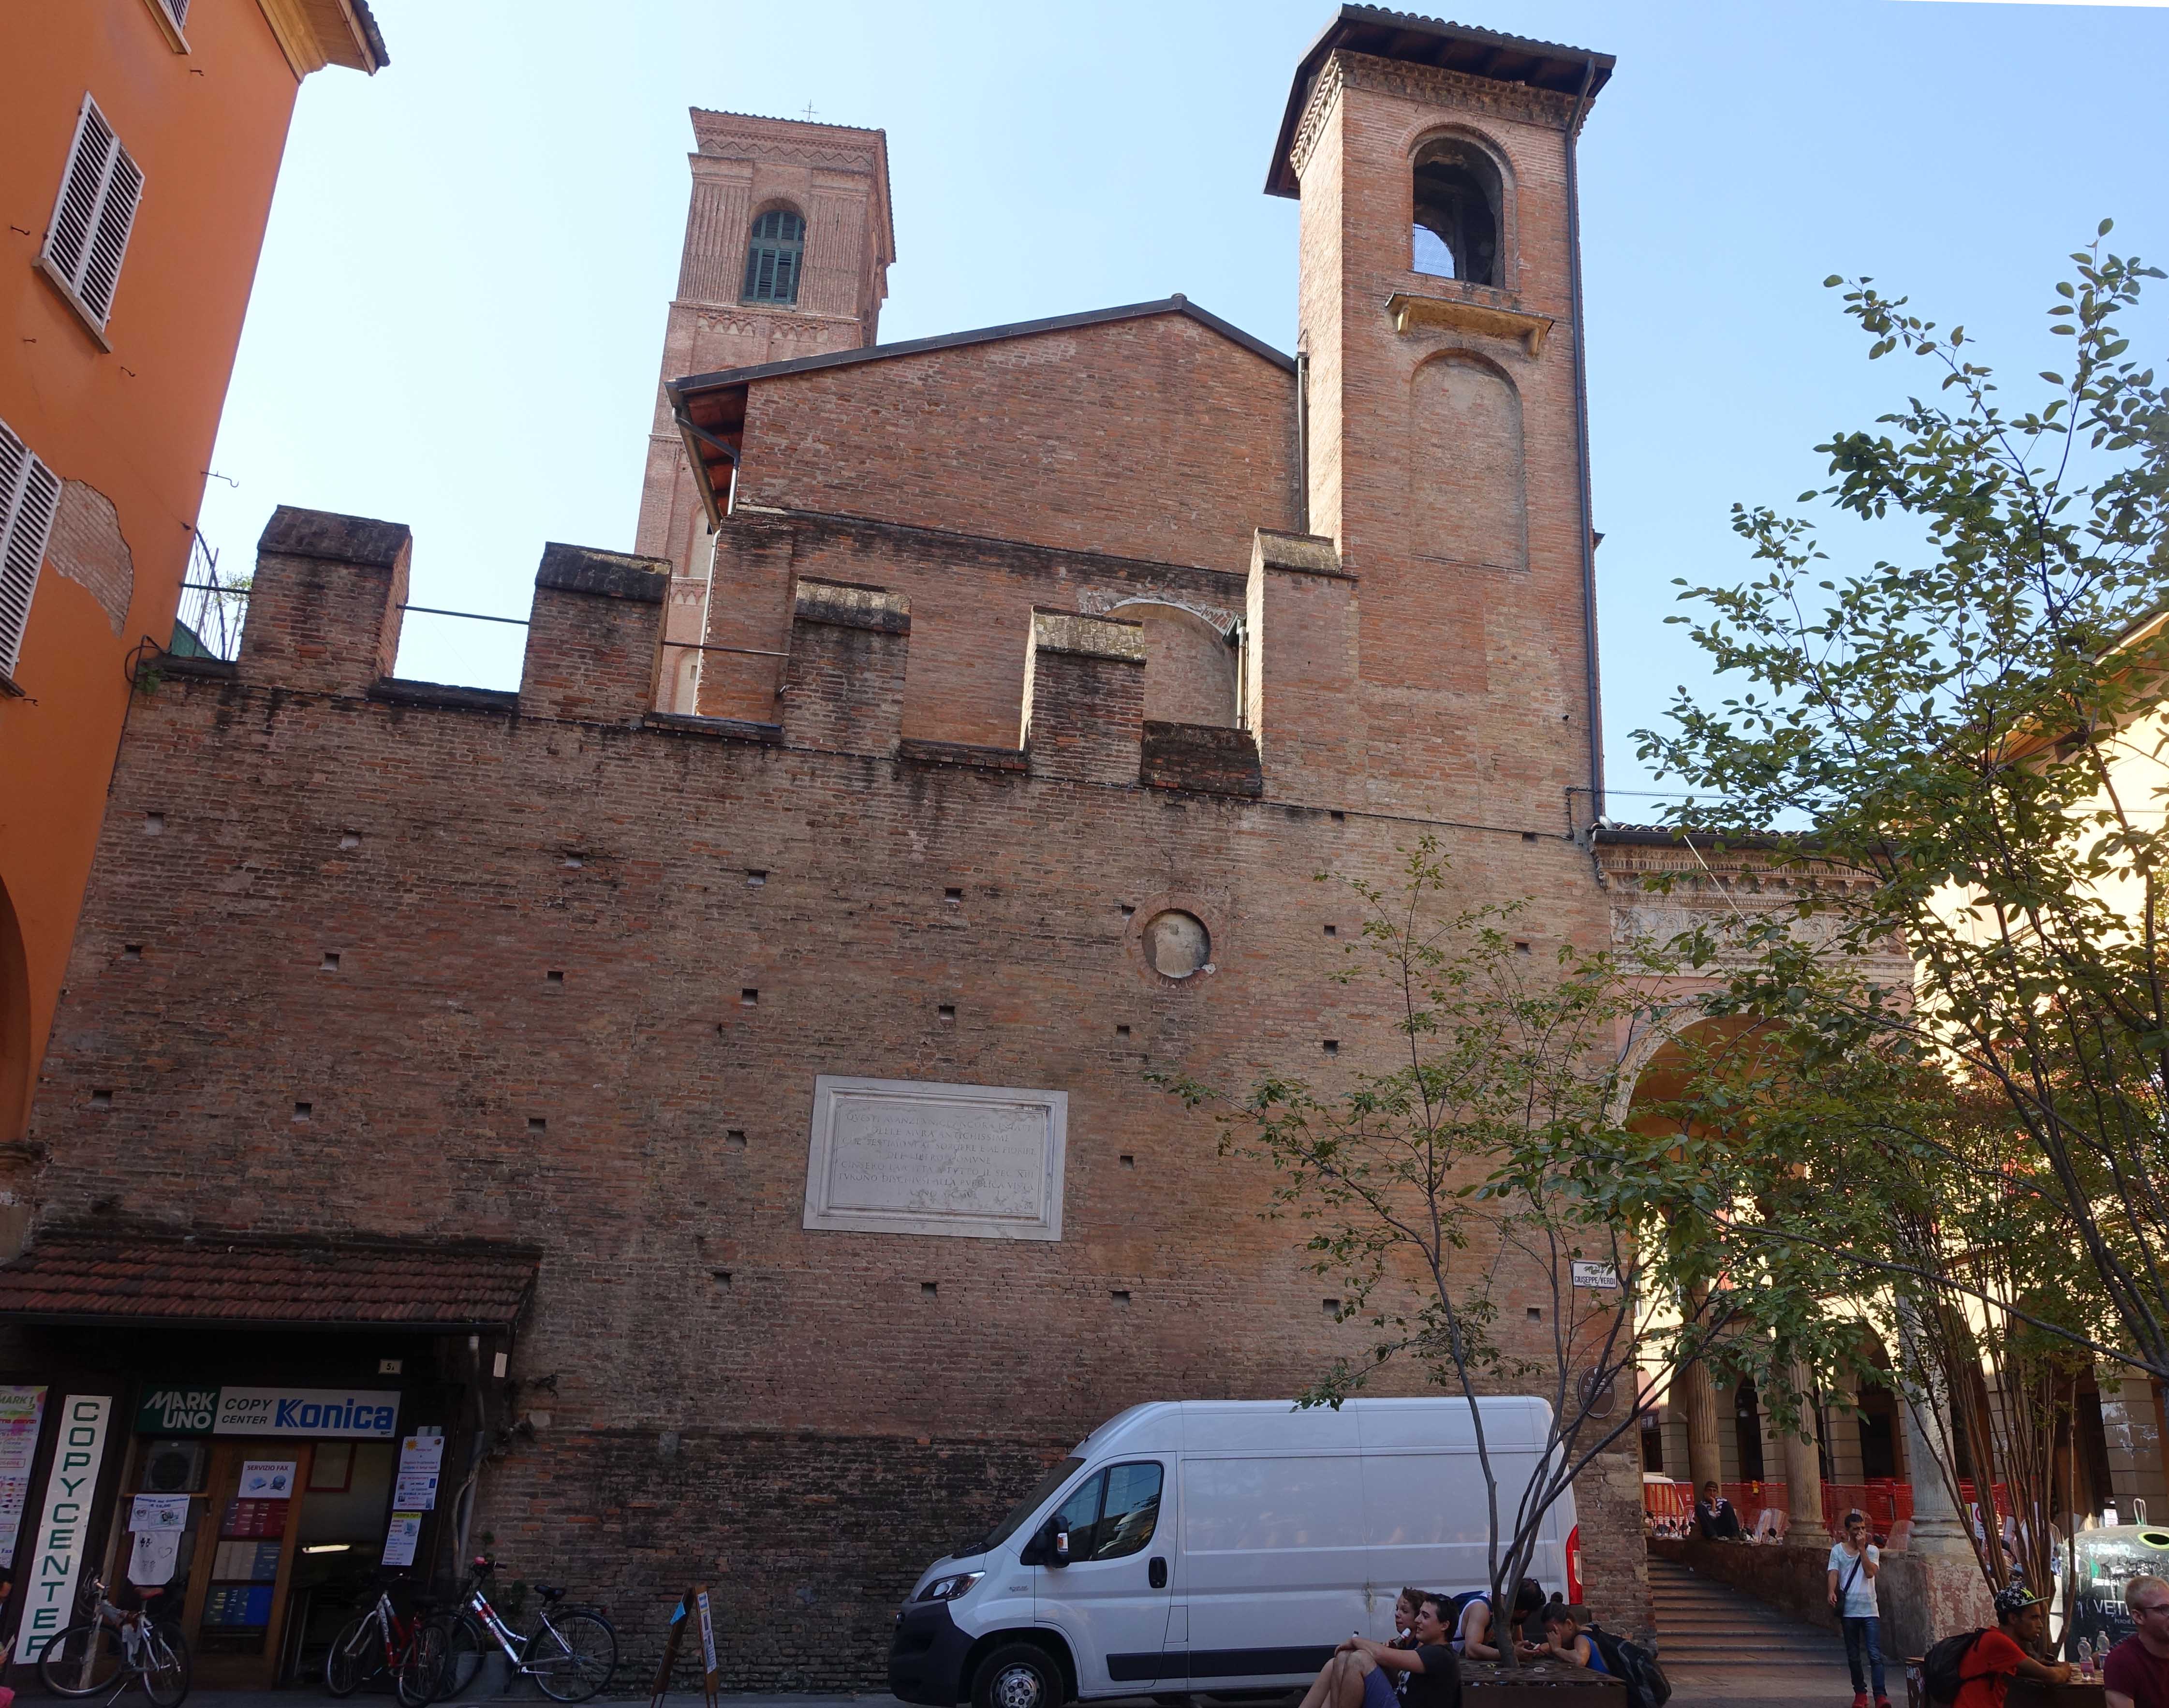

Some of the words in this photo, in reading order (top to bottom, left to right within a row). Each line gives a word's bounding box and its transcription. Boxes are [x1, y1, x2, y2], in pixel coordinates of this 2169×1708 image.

[1574, 1275, 1598, 1284] GIUSEPPE
[1600, 1276, 1616, 1285] VERDI
[143, 1391, 216, 1411] MARK
[225, 1398, 273, 1411] COPY
[162, 1411, 212, 1429] UNO
[221, 1415, 267, 1424] CENTER
[275, 1398, 394, 1430] Konica
